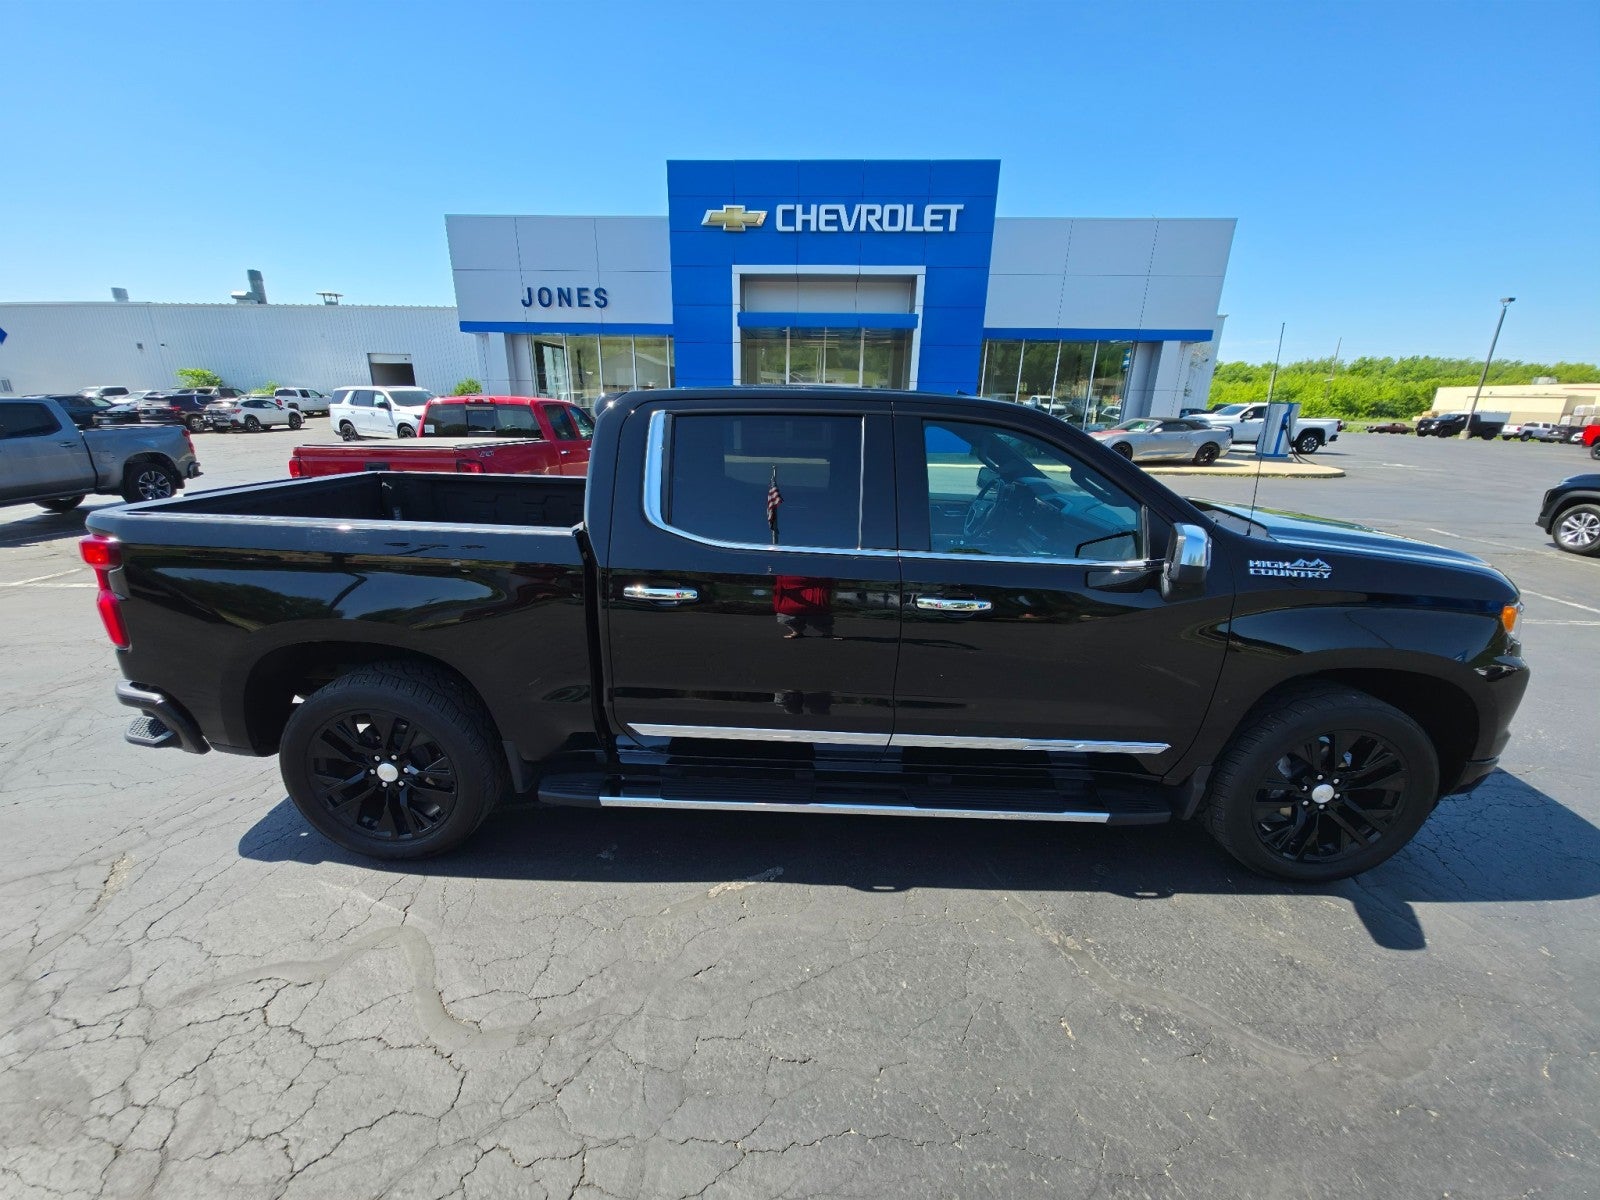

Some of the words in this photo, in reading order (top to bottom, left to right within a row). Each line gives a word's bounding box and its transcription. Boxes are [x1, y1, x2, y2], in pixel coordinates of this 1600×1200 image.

[775, 203, 965, 233] CHEVROLET
[521, 286, 609, 309] JONES
[1249, 559, 1291, 569] HIGH
[1249, 568, 1332, 579] COUNTRY
